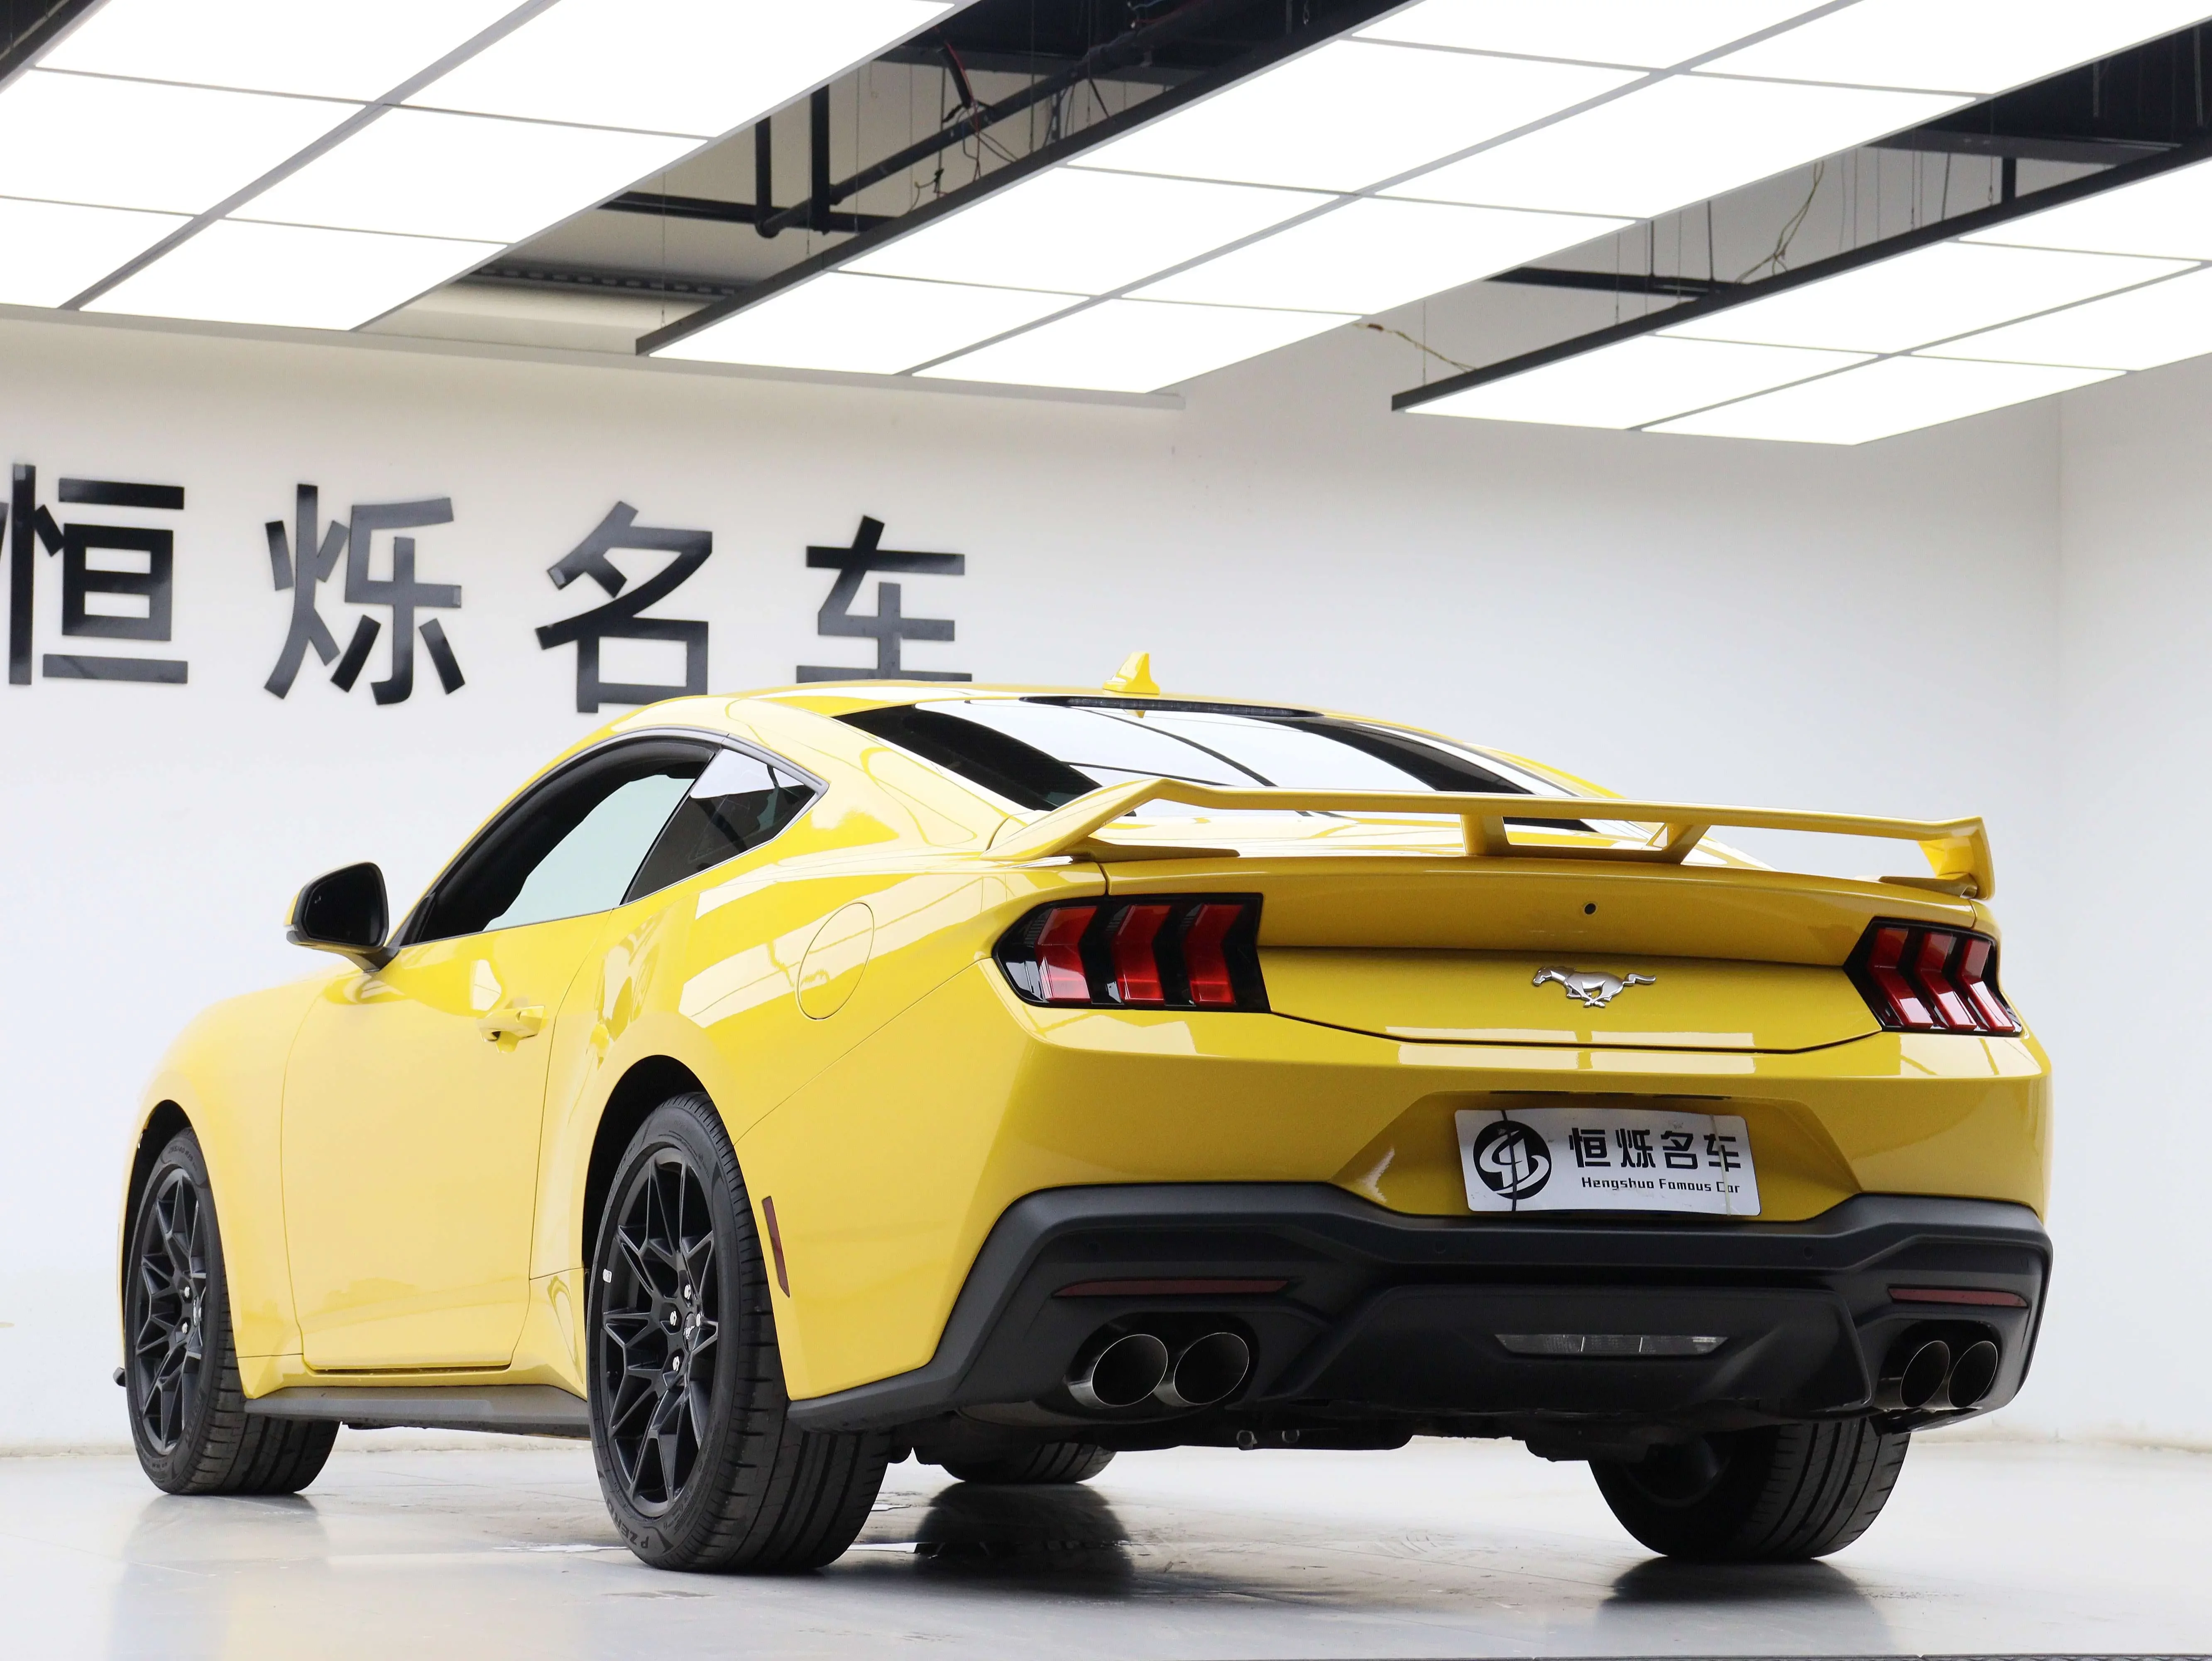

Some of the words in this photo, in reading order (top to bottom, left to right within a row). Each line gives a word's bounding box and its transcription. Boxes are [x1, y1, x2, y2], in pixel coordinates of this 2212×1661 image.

[0, 463, 972, 714] 恒烁名车
[1569, 1127, 1741, 1172] 恒烁名车
[1581, 1177, 1654, 1191] Hengshuo
[1659, 1178, 1712, 1192] Famous
[1716, 1182, 1740, 1193] Car
